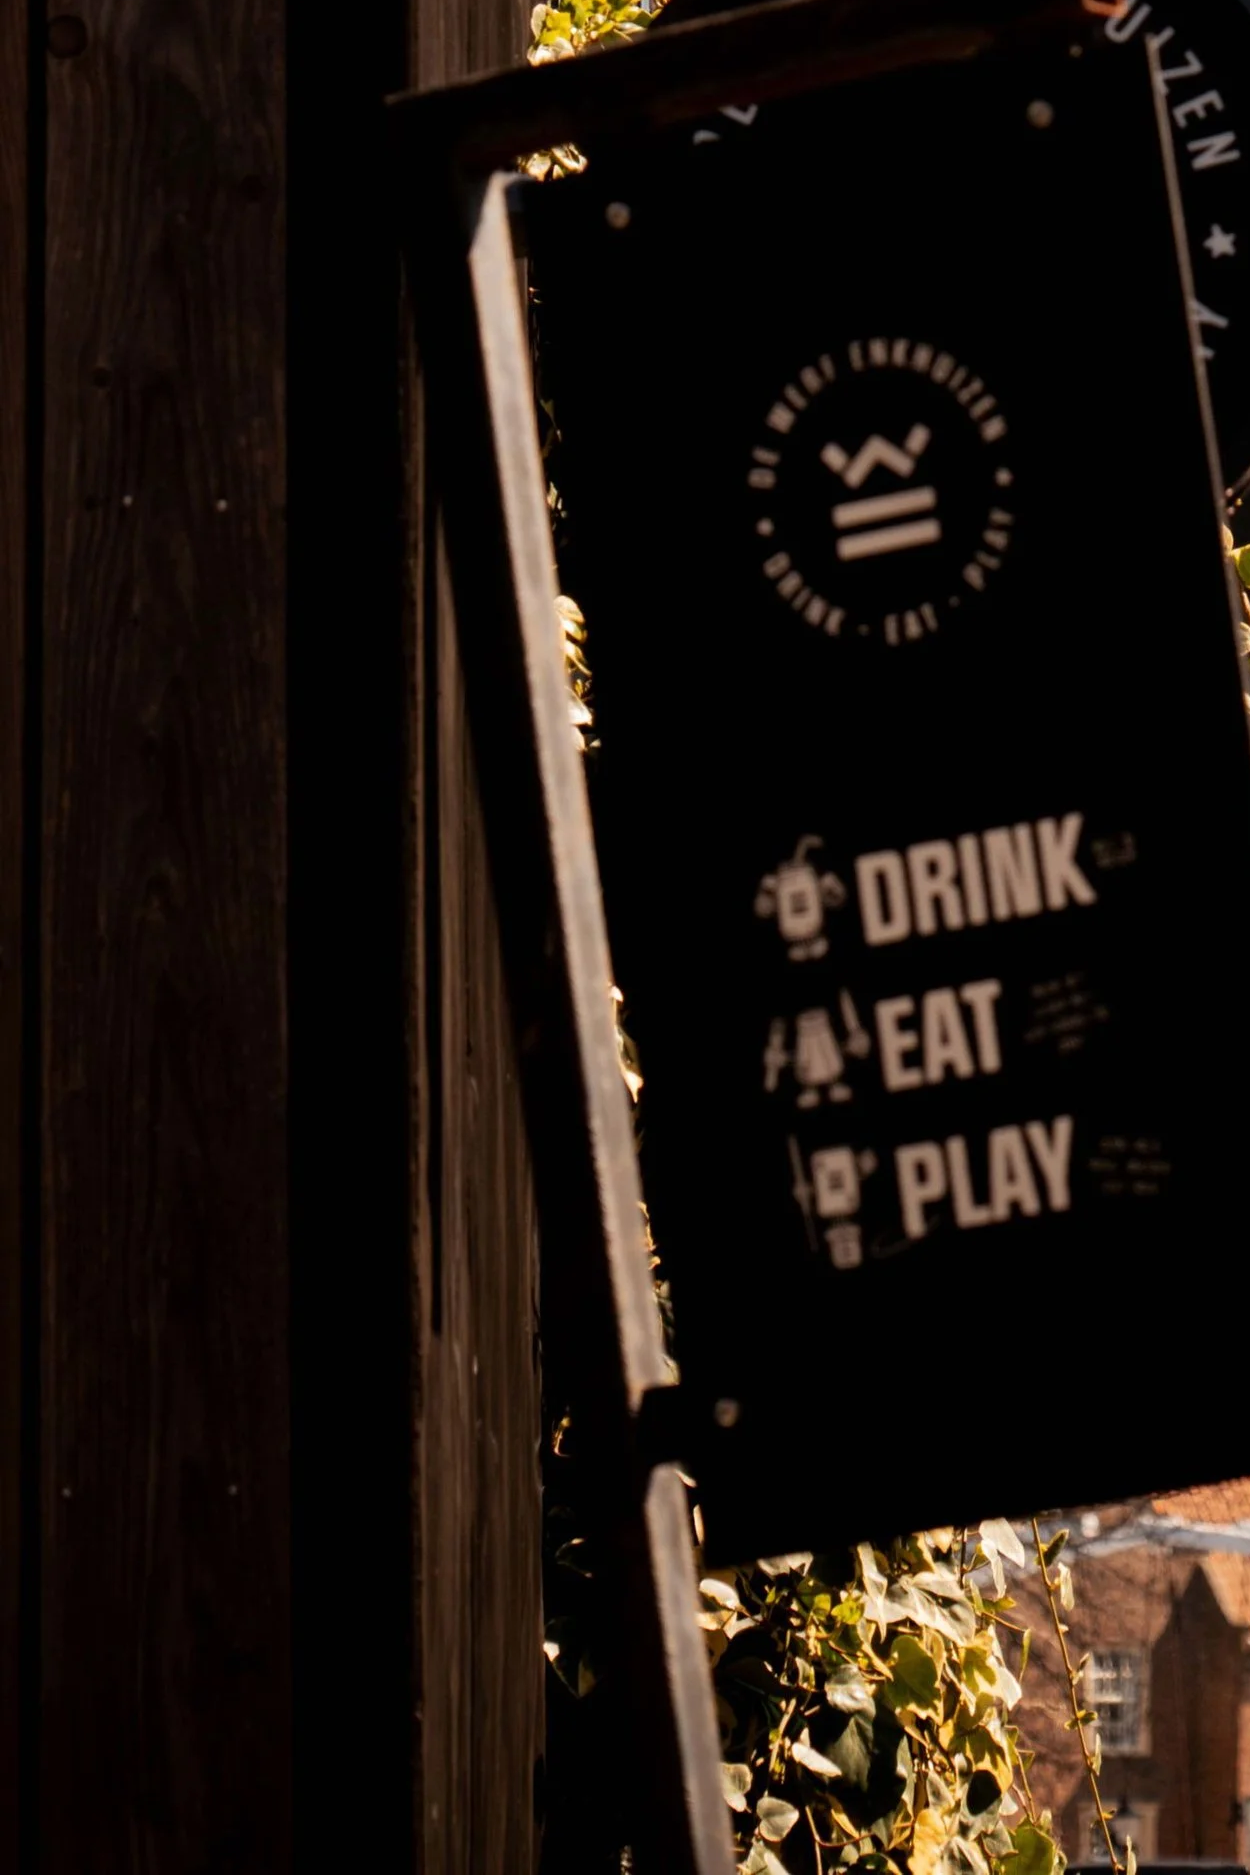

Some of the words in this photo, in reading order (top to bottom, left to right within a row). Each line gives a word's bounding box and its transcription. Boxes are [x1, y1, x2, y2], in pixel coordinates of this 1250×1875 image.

[855, 812, 1095, 945] DRINK
[874, 978, 1002, 1092] EAT
[895, 1115, 1073, 1240] PLAY
